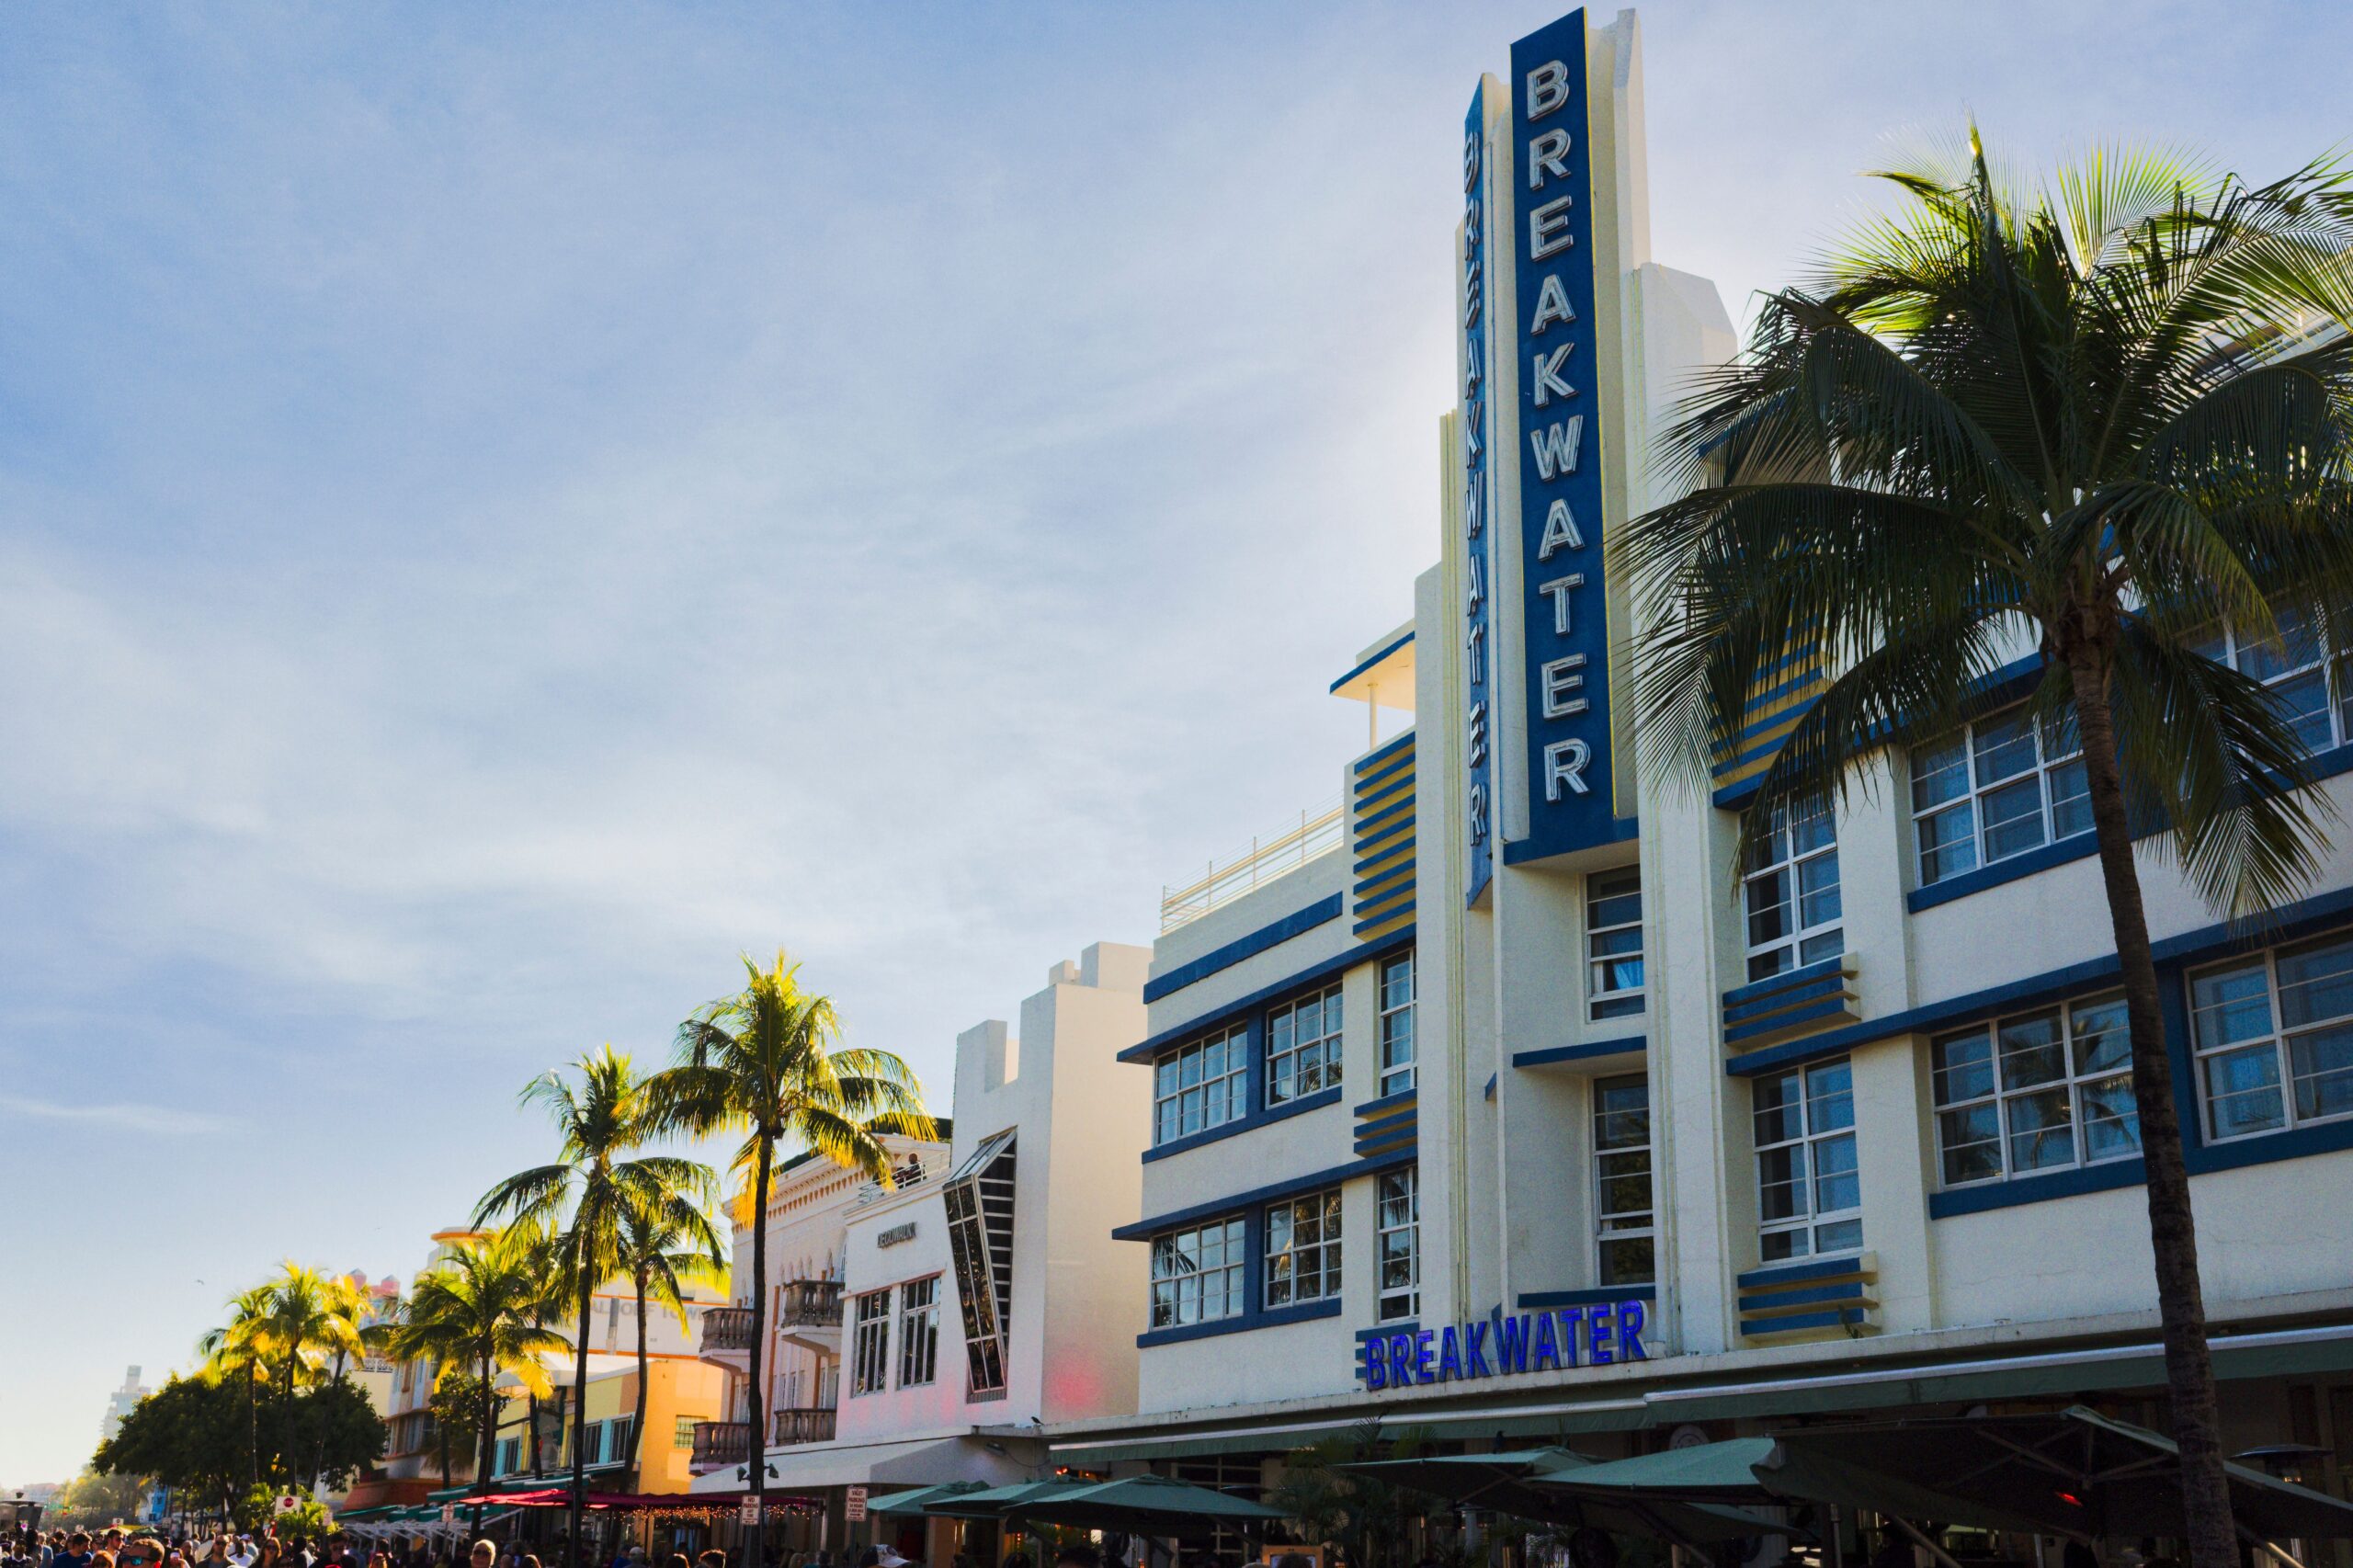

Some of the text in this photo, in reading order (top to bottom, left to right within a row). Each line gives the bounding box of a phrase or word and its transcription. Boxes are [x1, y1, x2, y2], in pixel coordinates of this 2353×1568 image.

[1463, 131, 1486, 846] BREAKWATER
[1527, 60, 1591, 801] BREAKWATER
[1365, 1300, 1647, 1391] BREAKWATER
